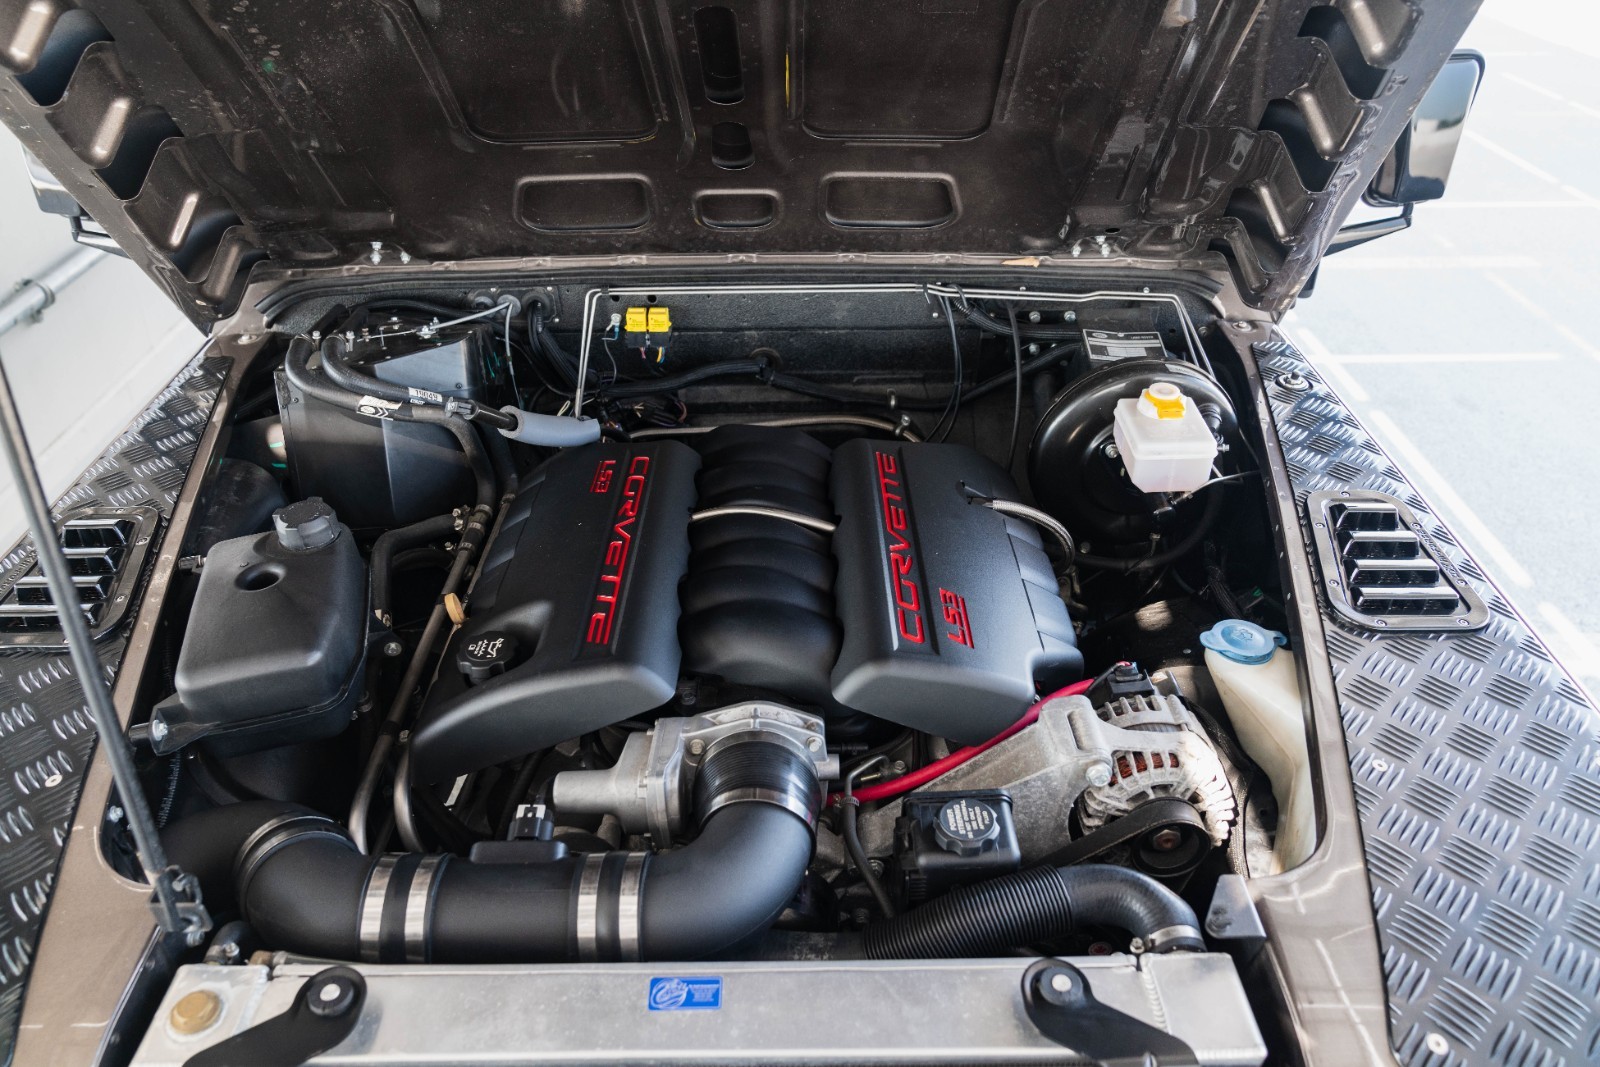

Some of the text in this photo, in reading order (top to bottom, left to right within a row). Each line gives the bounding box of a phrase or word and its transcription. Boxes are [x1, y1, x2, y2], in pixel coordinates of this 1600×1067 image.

[592, 460, 616, 492] LS3
[586, 456, 649, 645] CORVETTE
[876, 451, 925, 643] CORVETTE
[939, 587, 971, 647] LS3
